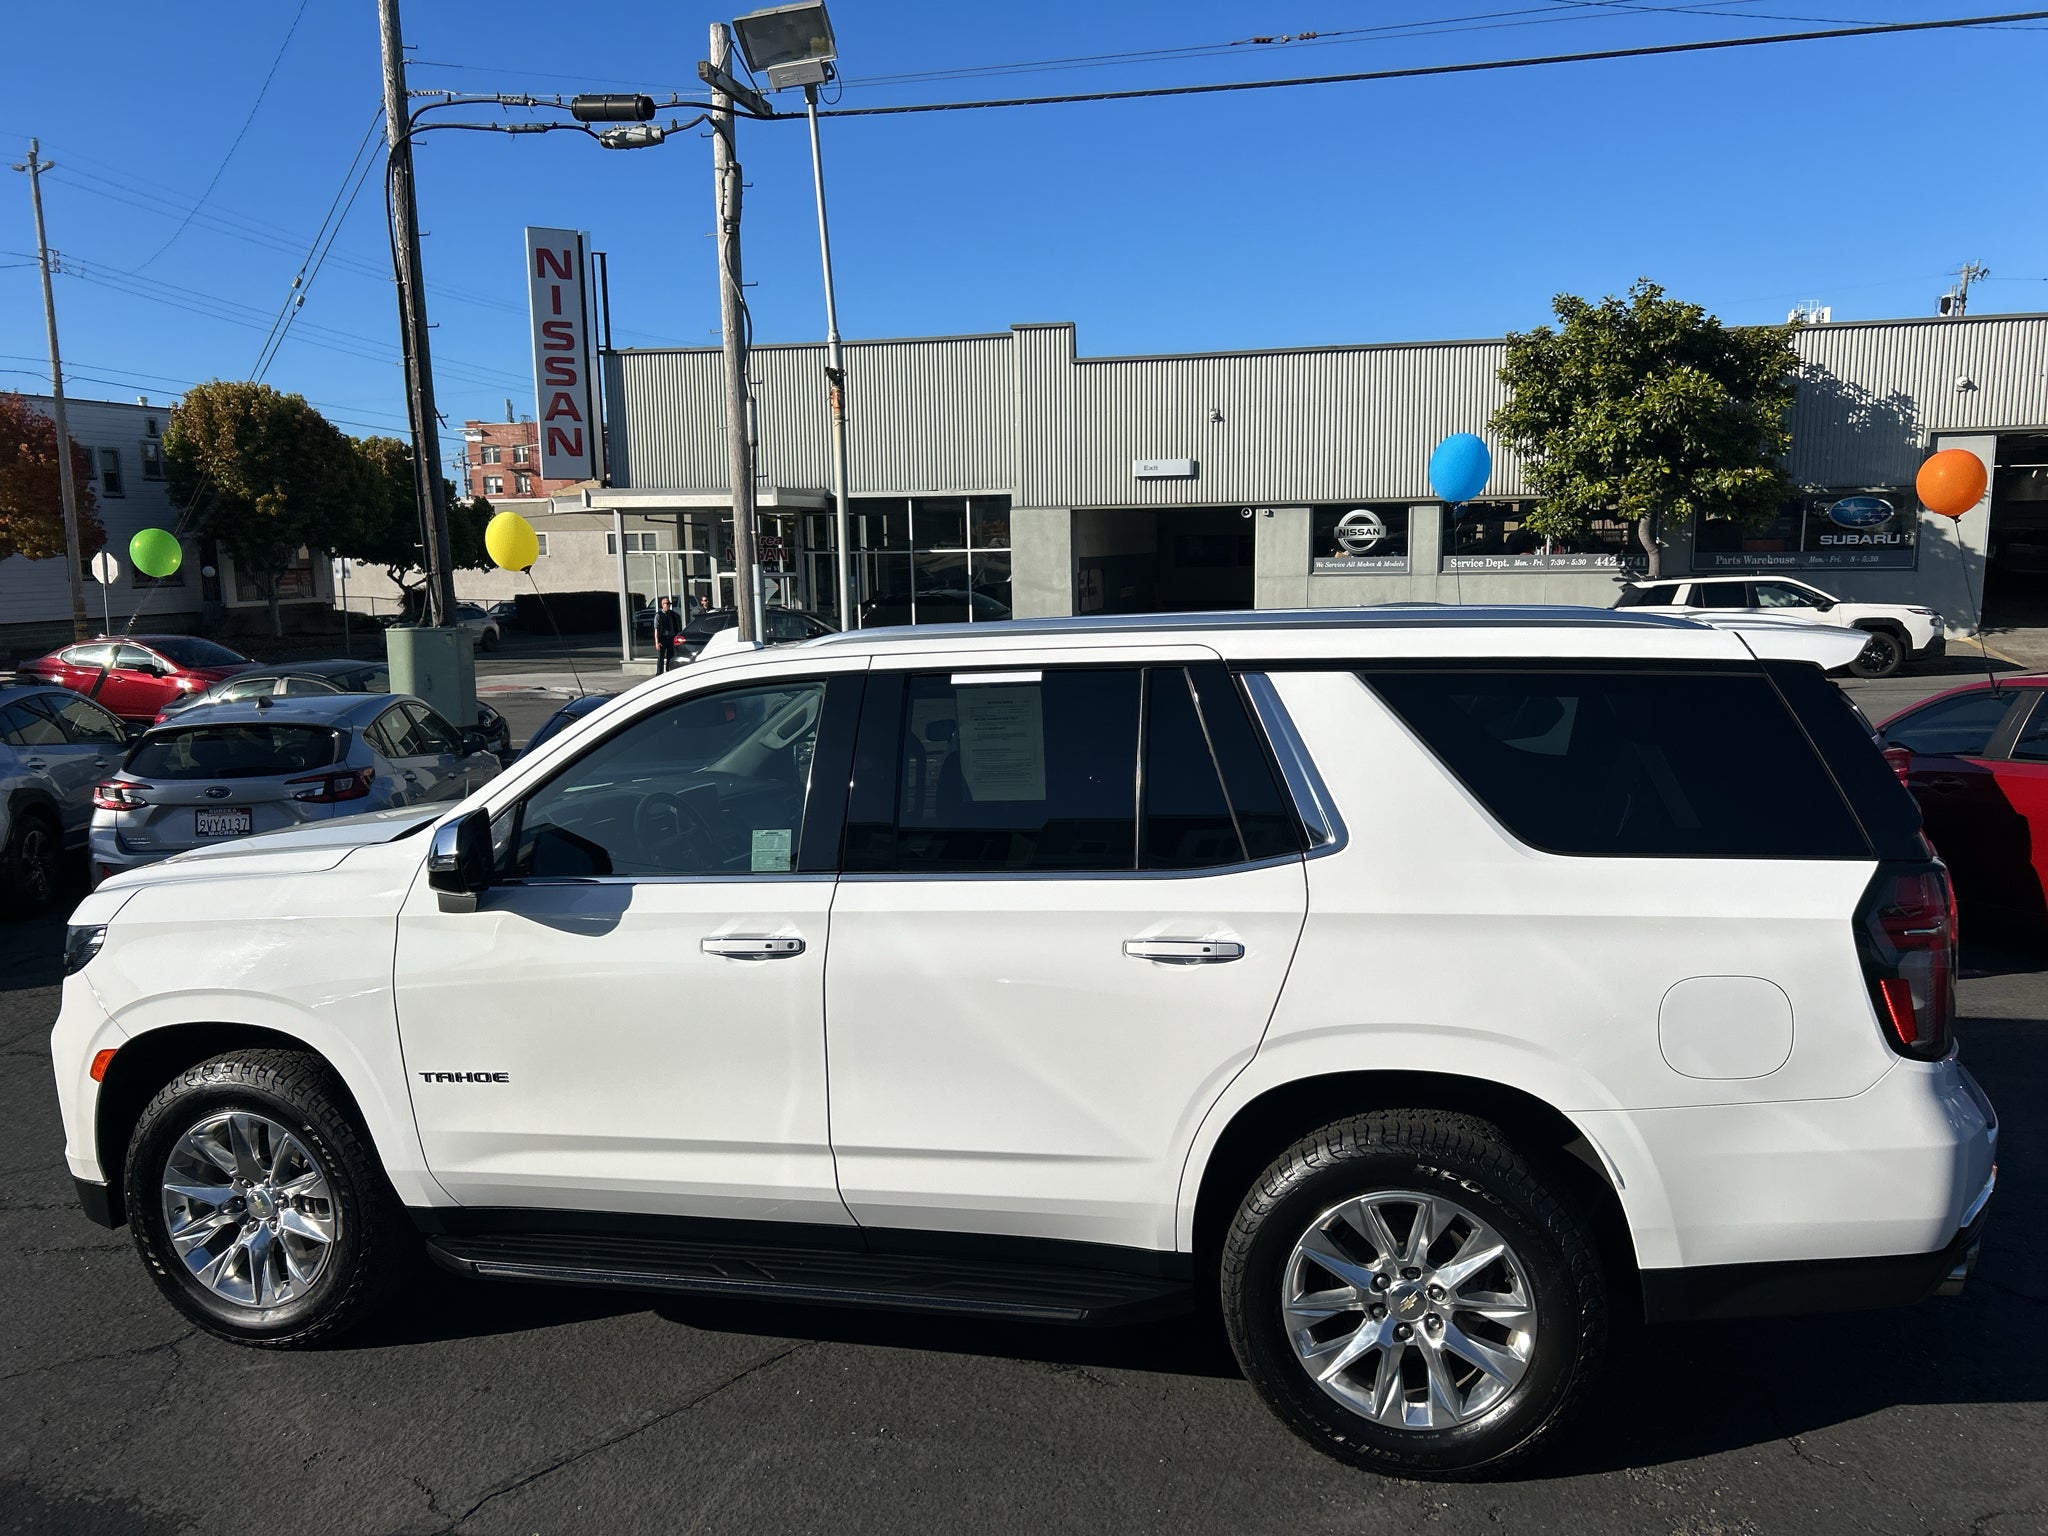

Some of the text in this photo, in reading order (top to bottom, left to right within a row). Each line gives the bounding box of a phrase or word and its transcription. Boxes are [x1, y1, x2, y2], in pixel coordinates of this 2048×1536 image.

[535, 247, 583, 457] NISSAN
[1338, 528, 1381, 537] NISSAN
[1819, 533, 1901, 545] SUBARU
[1383, 560, 1405, 568] Models
[1450, 558, 1484, 568] Service
[1485, 558, 1510, 569] Dept.
[1550, 558, 1566, 566] 7:30
[1571, 558, 1587, 566] 5:30
[1715, 554, 1796, 565] Parts Warehouse
[418, 1071, 510, 1083] TAHOE
